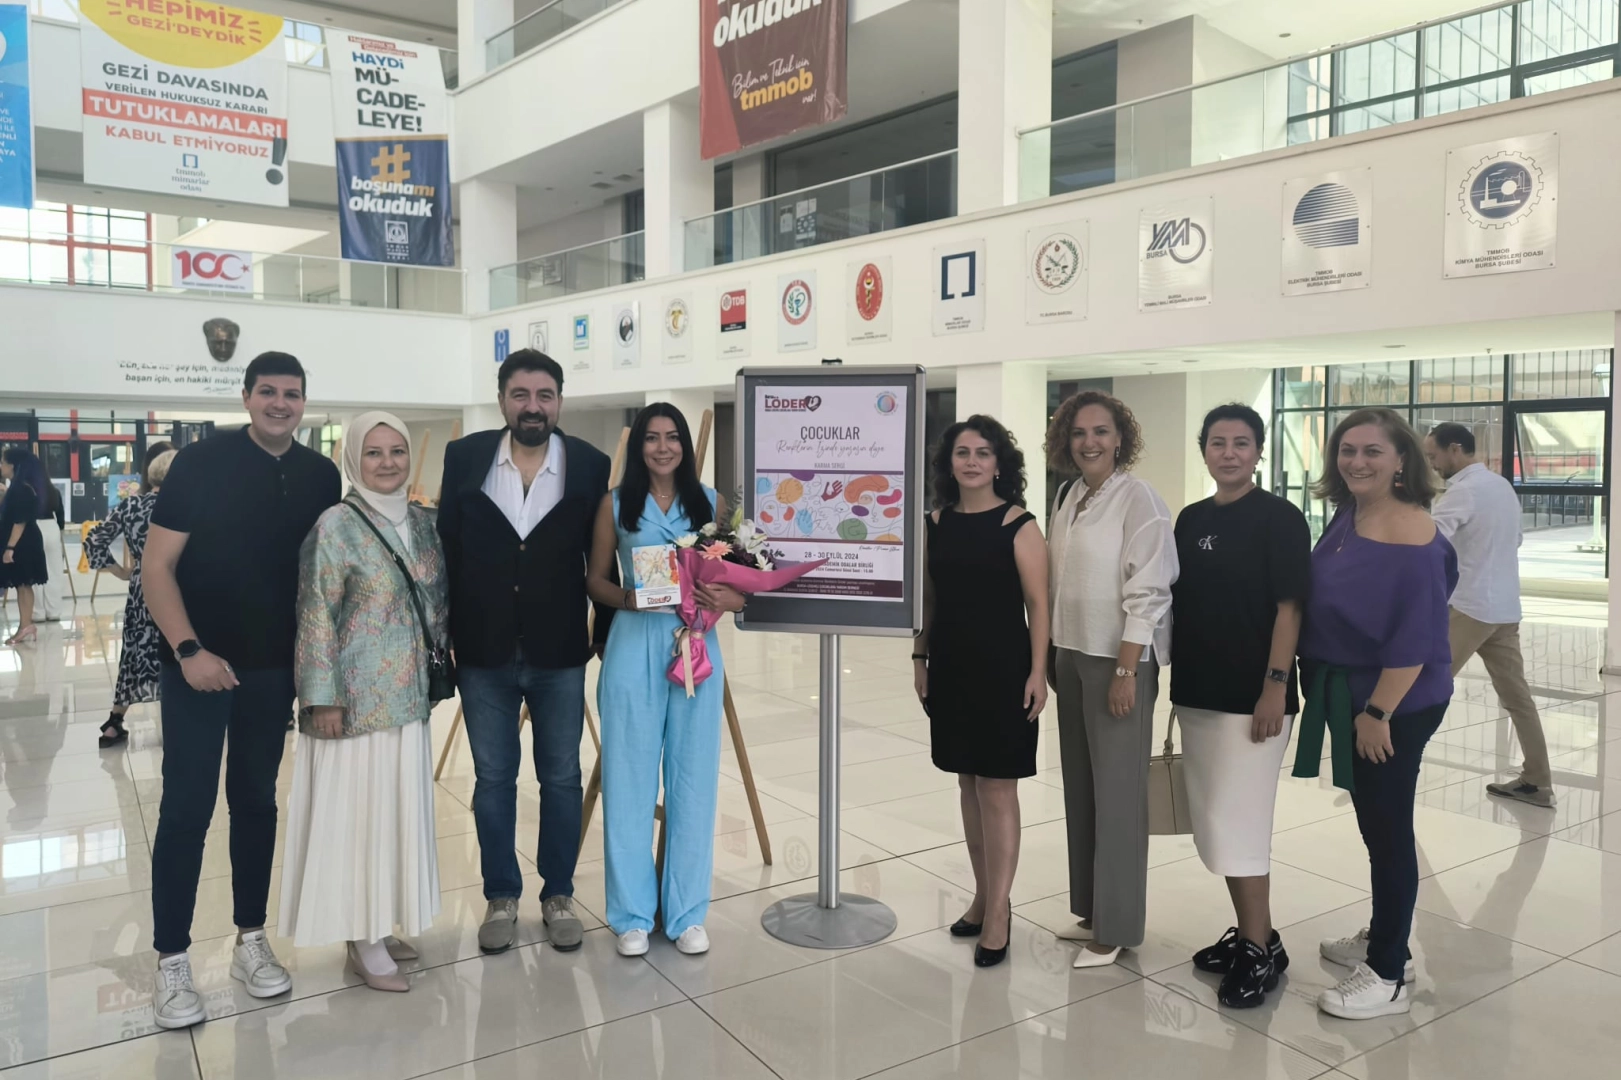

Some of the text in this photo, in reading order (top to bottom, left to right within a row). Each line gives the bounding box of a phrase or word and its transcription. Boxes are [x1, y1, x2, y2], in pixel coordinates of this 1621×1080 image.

[125, 0, 244, 30] HEPİMİZ
[713, 0, 822, 47] okudu
[127, 14, 246, 45] GEZİ'DEYDİK
[352, 51, 404, 69] HAYDİ
[102, 62, 269, 100] GEZİ DAVASINDA
[355, 67, 399, 85] MÜ-
[105, 82, 268, 115] VERİLEN HUKUKSUZ KARARI
[356, 88, 426, 111] CADE-
[740, 67, 813, 111] tmmob
[89, 95, 282, 138] TUTUKLAMALARI
[357, 109, 423, 132] LEYE!
[105, 125, 269, 158] KABUL ETMİYORUZ
[349, 193, 434, 217] okuduk
[1146, 250, 1168, 259] BURSA
[187, 376, 211, 384] hakiki
[765, 398, 807, 409] LÖDER
[800, 426, 860, 442] ÇOCUKLAR
[826, 552, 843, 560] EYLÜL
